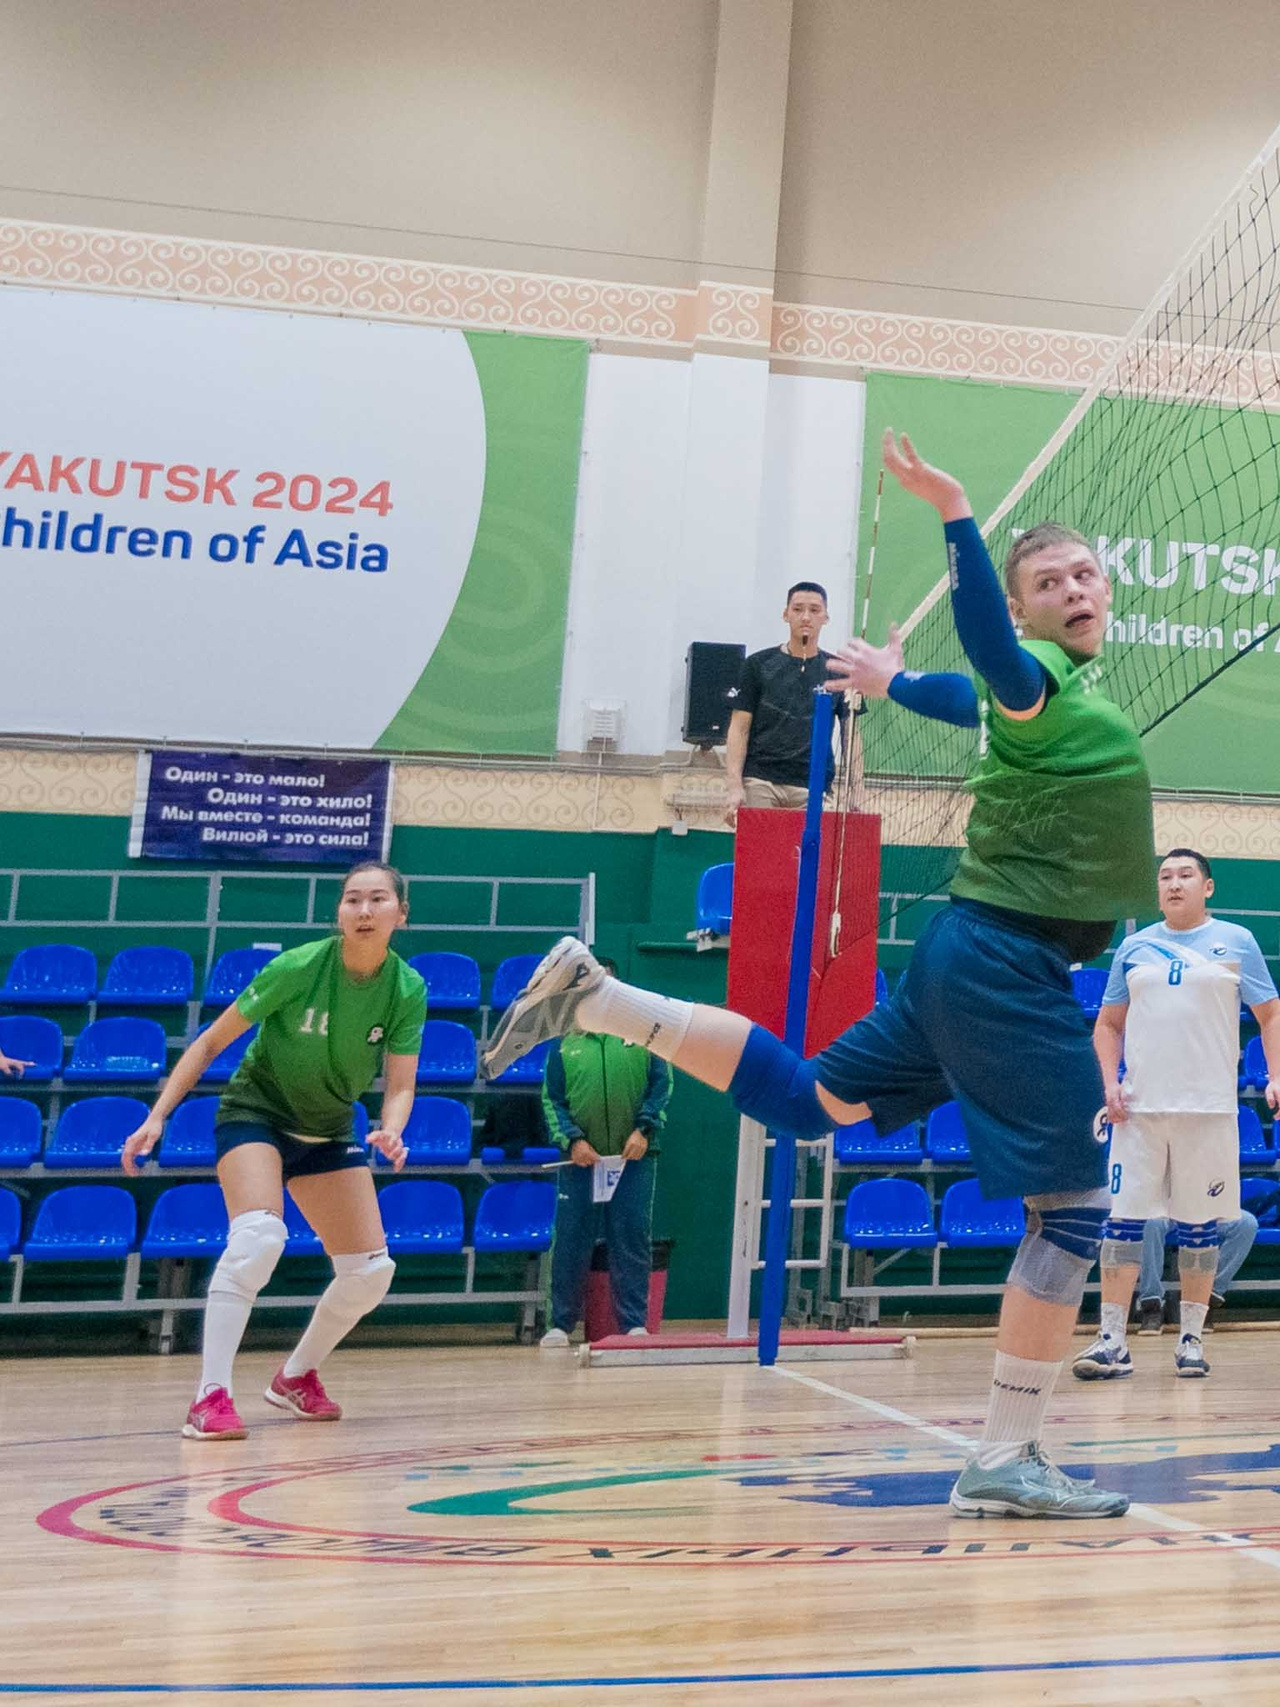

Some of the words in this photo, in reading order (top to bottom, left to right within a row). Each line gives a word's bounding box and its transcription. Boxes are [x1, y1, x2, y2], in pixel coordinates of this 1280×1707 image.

[252, 471, 394, 517] 2024
[2, 506, 193, 560] hildren
[208, 524, 267, 565] of
[273, 528, 389, 573] Asia
[1105, 611, 1224, 650] hildren
[1233, 622, 1270, 652] of
[165, 766, 217, 783] Один
[234, 775, 264, 785] это
[268, 774, 325, 788] мало!
[207, 788, 262, 805] Один
[280, 796, 312, 808] это
[316, 794, 373, 809] хило!
[161, 806, 193, 821] Мы
[198, 812, 263, 824] вместе
[279, 813, 370, 828] команда!
[202, 827, 268, 843] Вилюй
[284, 833, 315, 845] это
[318, 832, 369, 846] сила!
[1168, 960, 1184, 986] 8
[1110, 1163, 1122, 1195] 8
